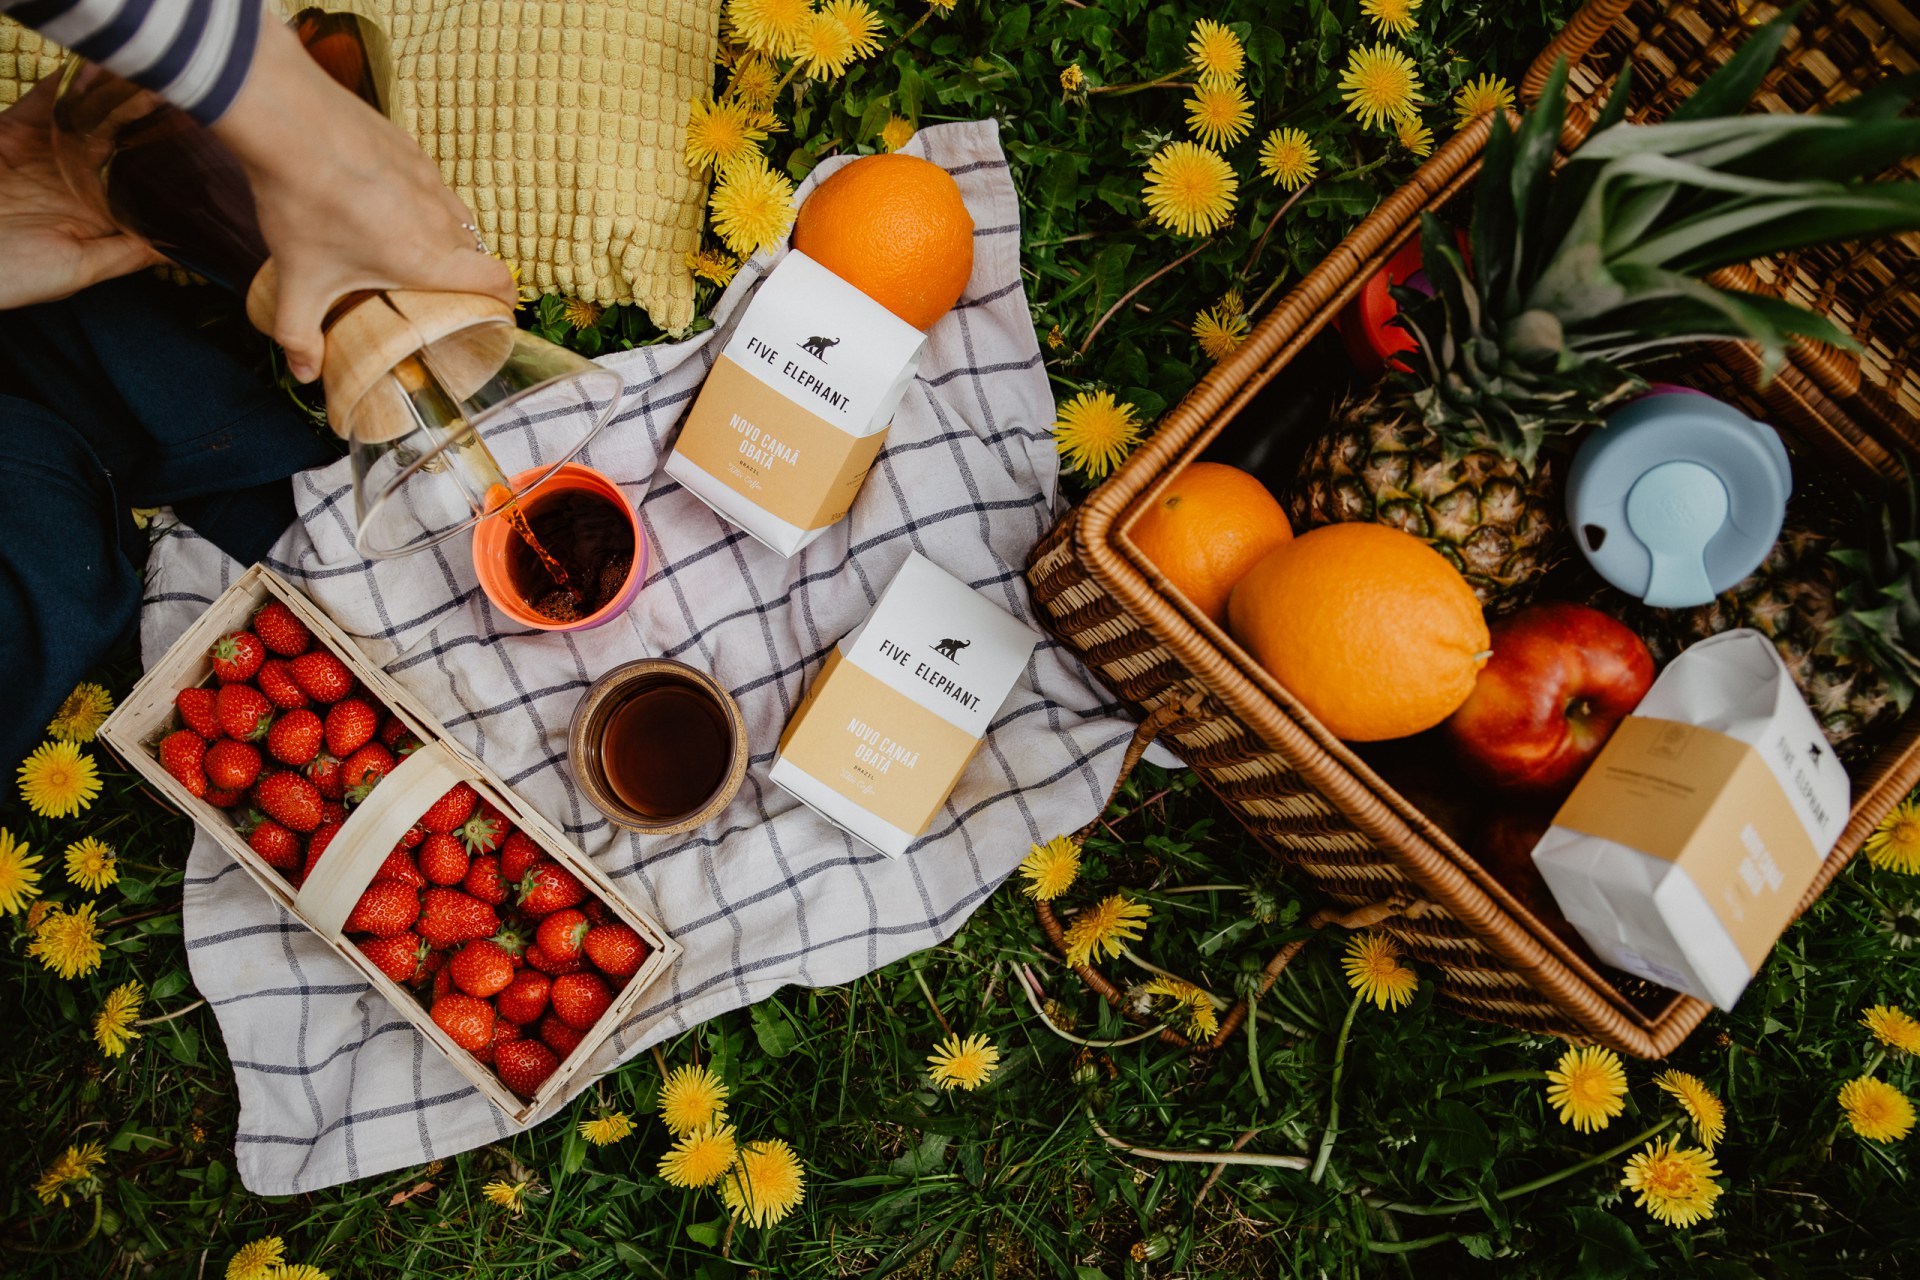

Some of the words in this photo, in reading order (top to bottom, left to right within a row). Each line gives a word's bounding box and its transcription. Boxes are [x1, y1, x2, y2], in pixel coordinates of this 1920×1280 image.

[747, 337, 779, 365] FIVE
[783, 360, 850, 414] ELEPHANT.
[729, 413, 761, 442] NOVO
[739, 460, 760, 477] BRAZIL
[879, 639, 911, 667] FIVE
[914, 662, 981, 713] ELEPHANT.
[847, 718, 880, 746] NOVO
